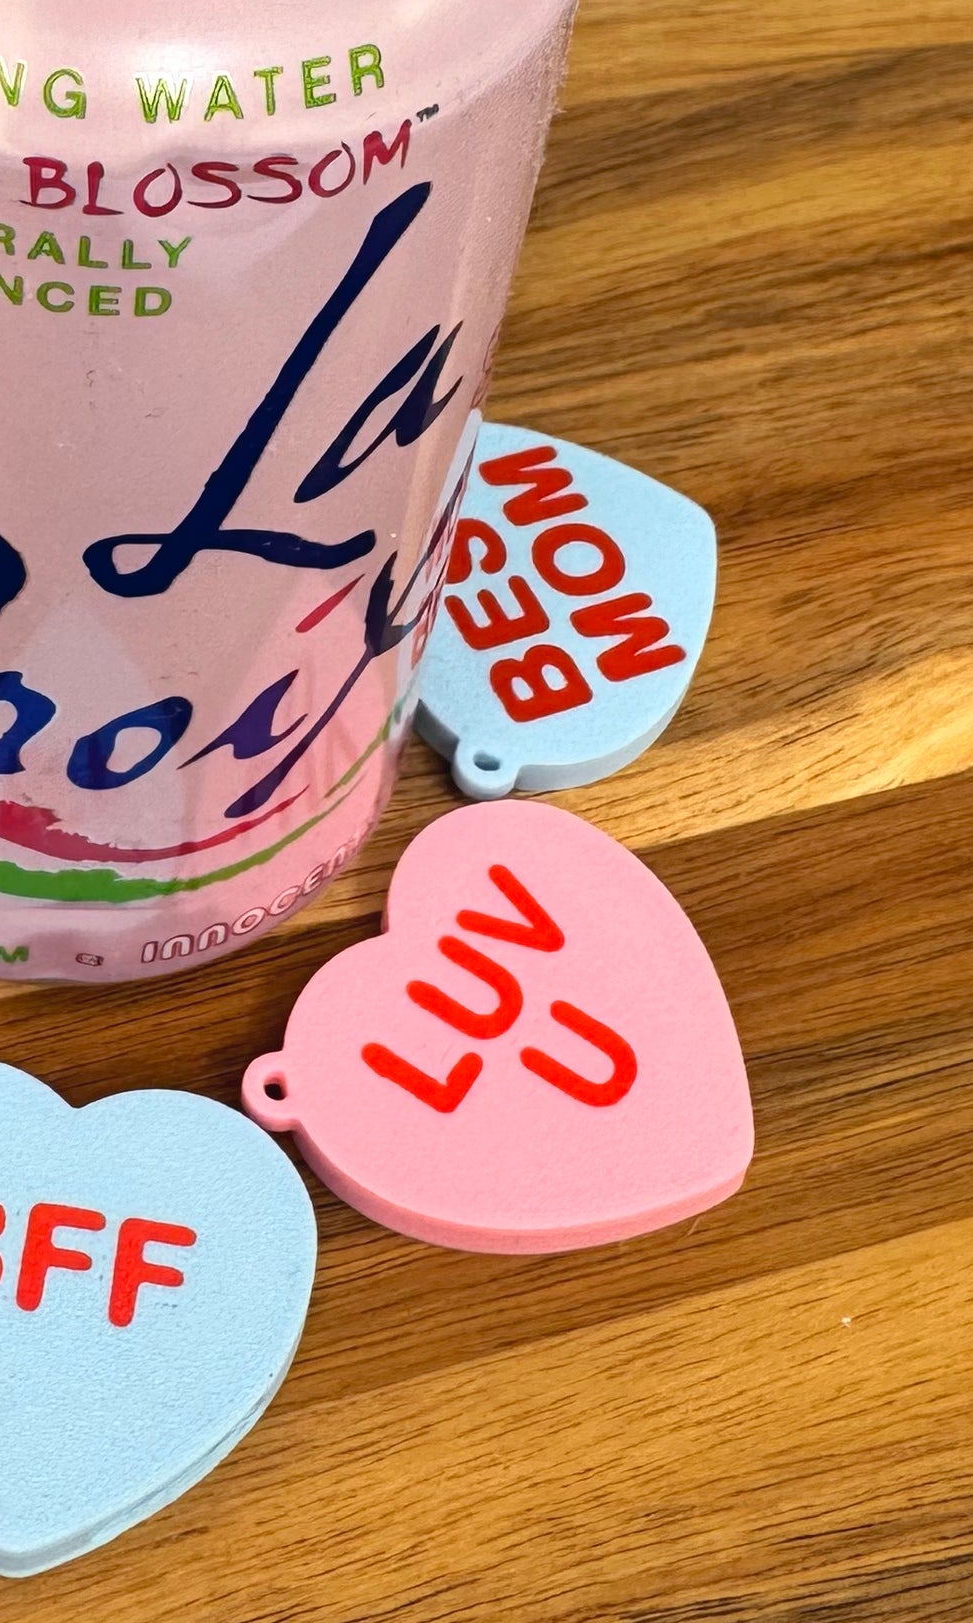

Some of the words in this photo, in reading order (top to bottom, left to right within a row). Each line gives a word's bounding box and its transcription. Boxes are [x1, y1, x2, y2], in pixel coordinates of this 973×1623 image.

[135, 43, 385, 124] WATER
[82, 181, 463, 599] La
[443, 517, 594, 723] BES
[478, 445, 687, 682] MOM
[360, 863, 566, 1115] LUV
[519, 999, 639, 1108] U
